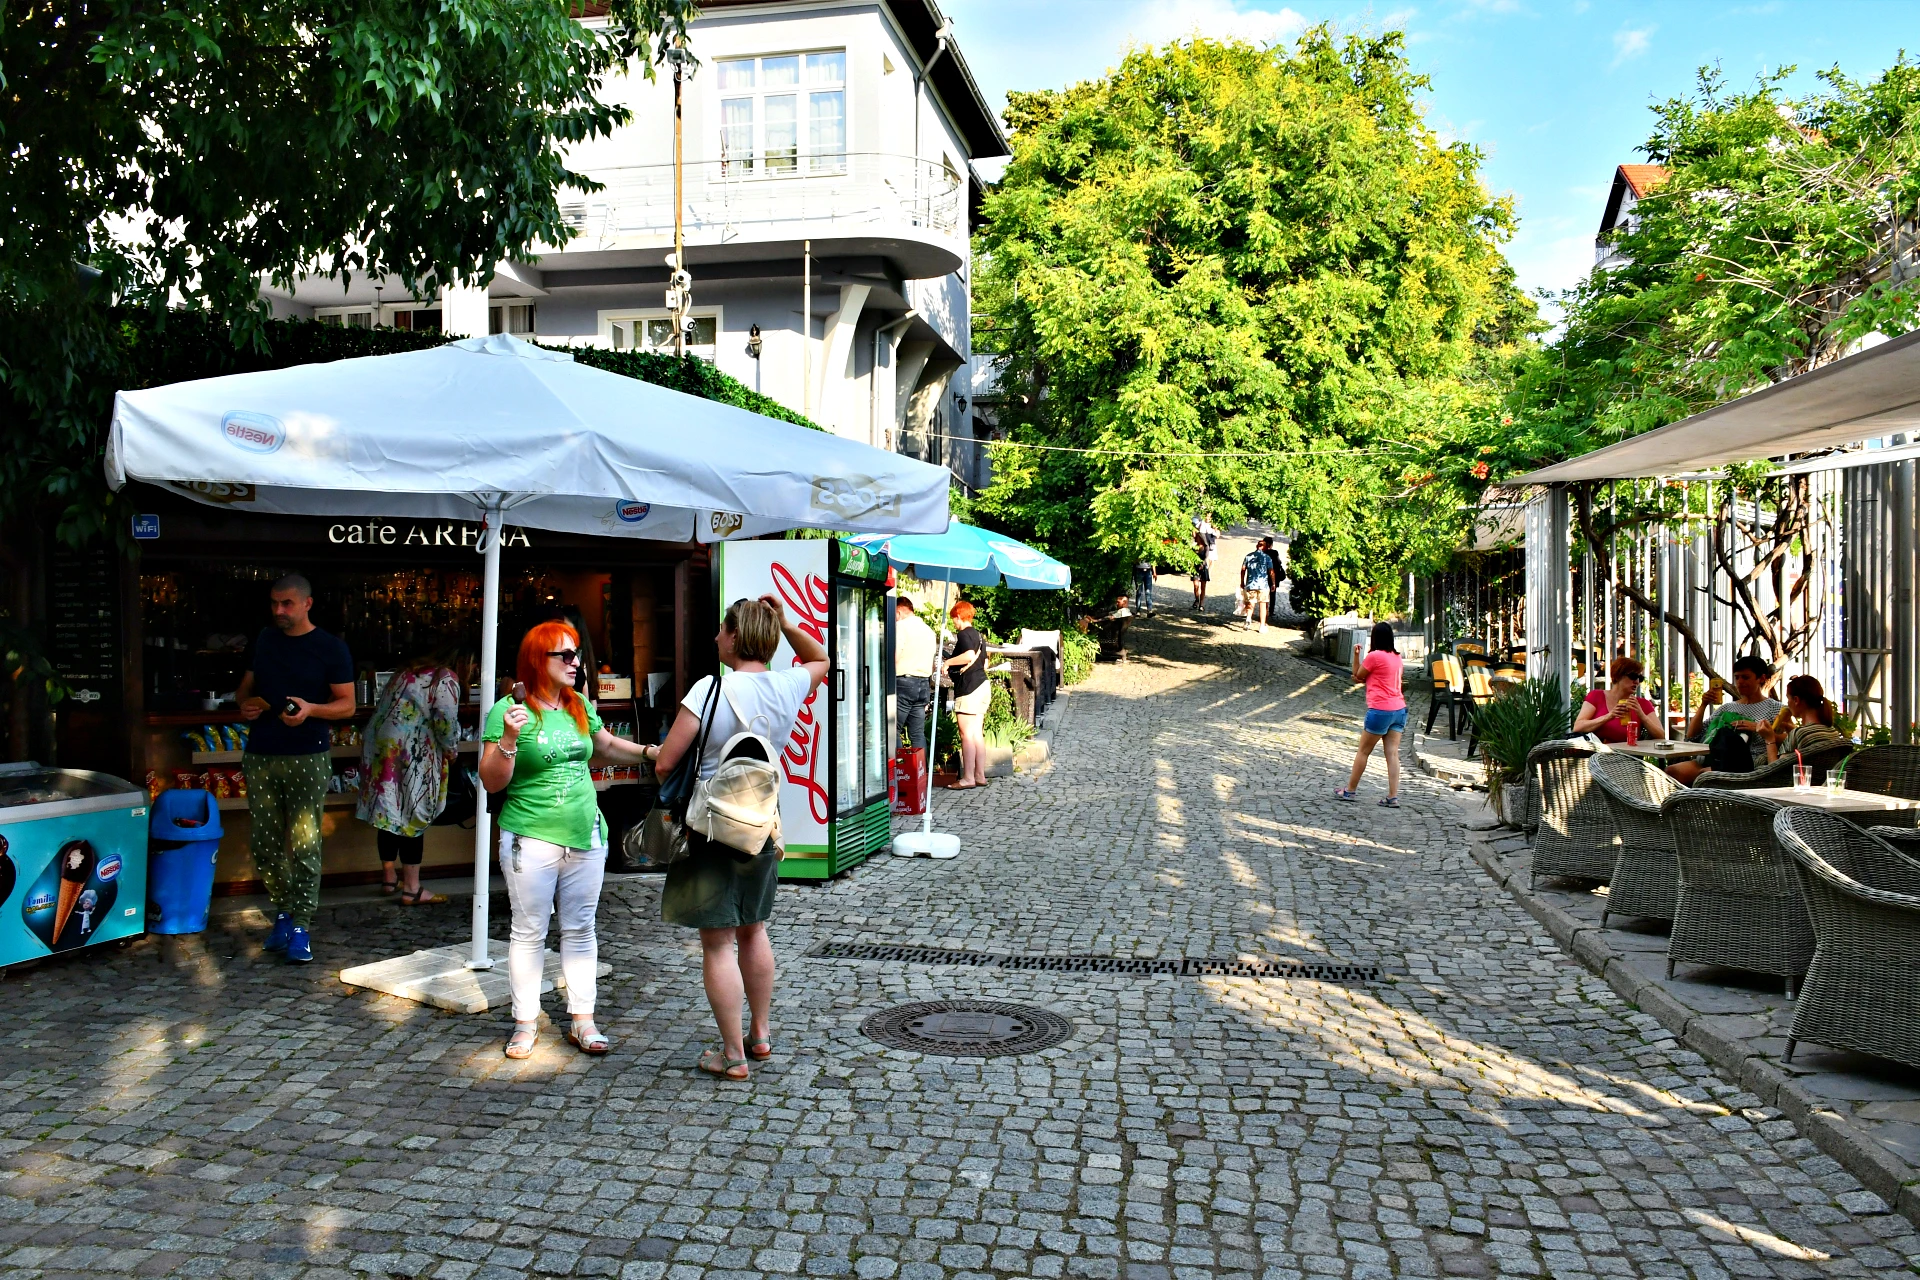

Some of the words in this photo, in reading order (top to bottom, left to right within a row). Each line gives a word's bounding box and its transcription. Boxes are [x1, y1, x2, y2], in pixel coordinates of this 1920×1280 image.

[712, 512, 741, 529] BOSS
[135, 525, 157, 533] WiFi
[328, 517, 396, 544] cafe
[403, 521, 531, 547] AREA
[27, 893, 56, 906] Familia
